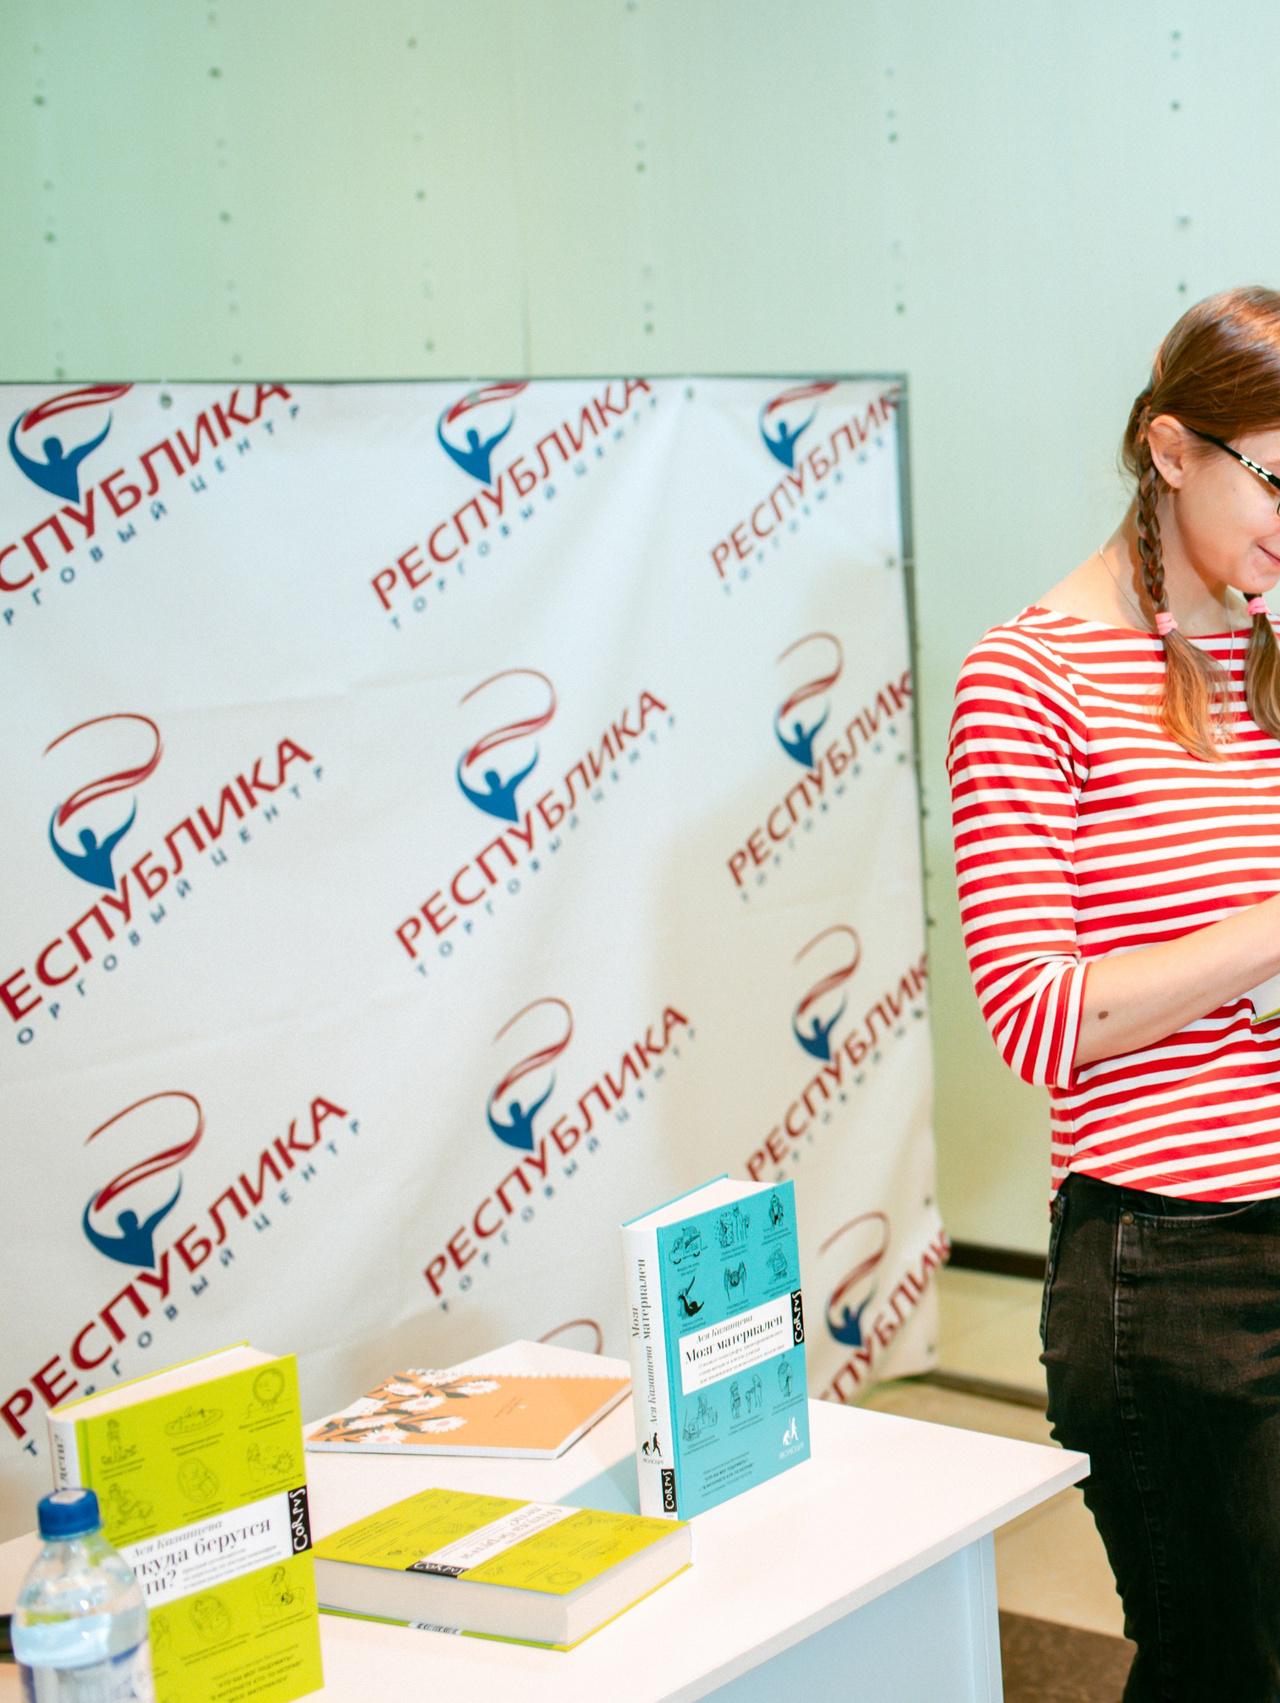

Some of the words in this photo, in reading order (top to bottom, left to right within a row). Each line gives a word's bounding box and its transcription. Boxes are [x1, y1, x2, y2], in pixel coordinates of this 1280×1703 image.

[371, 379, 651, 611] РЕСПУБЛИКА
[0, 737, 313, 1023] ЕСПУБЛИКА
[395, 691, 668, 959] РЕСПУБЛИКА
[0, 1095, 348, 1440] РЕСПУБЛИКА
[423, 1005, 688, 1297] РЕСПУБЛИКА
[638, 1259, 651, 1340] материален
[685, 1345, 713, 1364] Мозг
[716, 1315, 783, 1353] материален
[132, 1548, 188, 1577] ткуда
[194, 1519, 271, 1553] берутся
